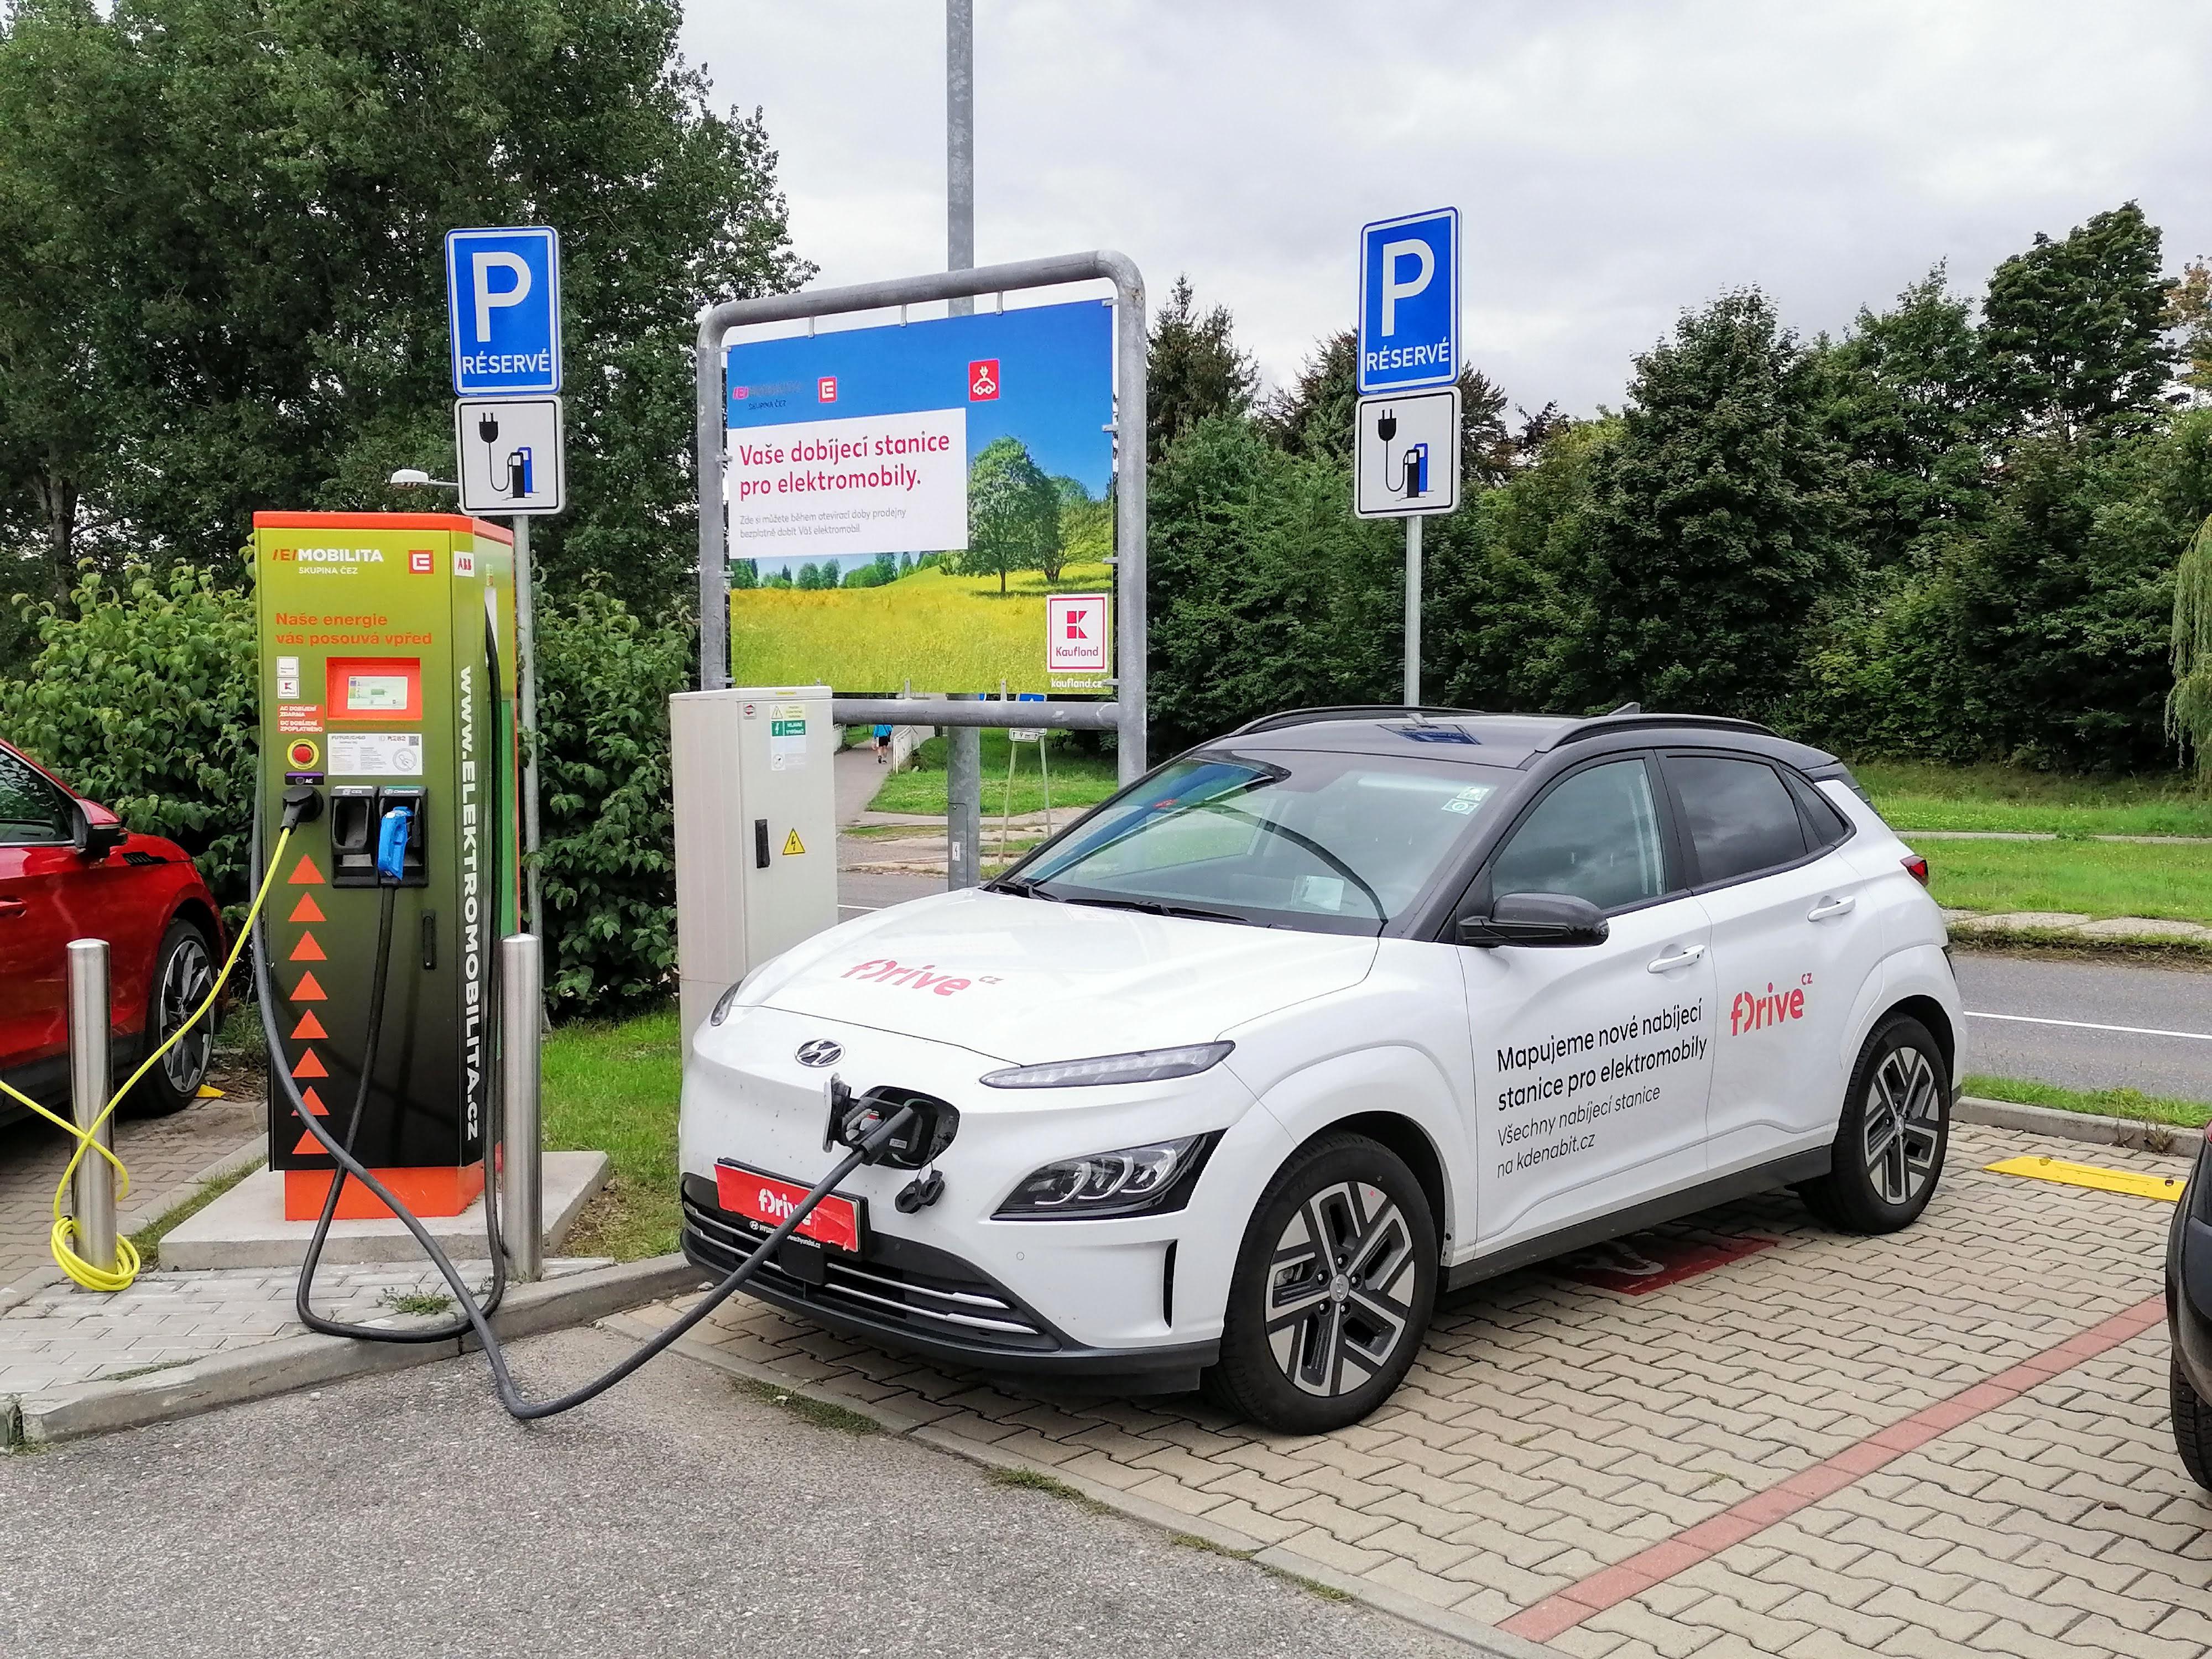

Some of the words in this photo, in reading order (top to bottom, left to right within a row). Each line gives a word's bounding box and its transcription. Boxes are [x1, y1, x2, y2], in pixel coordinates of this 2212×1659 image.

[472, 251, 531, 342] P
[1381, 238, 1435, 336] P
[462, 348, 550, 374] RÉSERVÉ
[1366, 336, 1449, 372] RÉSERVÉ
[739, 444, 784, 466] Vaše
[791, 436, 868, 465] dobíjecí
[875, 431, 950, 456] stanice
[740, 479, 771, 502] pro
[778, 463, 921, 493] elektromobily.
[740, 515, 754, 525] Zde
[852, 509, 871, 520] doby
[873, 508, 906, 519] prodejny
[340, 566, 358, 575] ČEZ
[457, 557, 472, 570] ABB
[276, 612, 318, 625] Naše
[323, 613, 388, 629] energie
[276, 632, 304, 644] vás
[309, 632, 379, 647] posouvá
[385, 632, 432, 647] vpřed
[1056, 646, 1099, 657] Kaufland
[1051, 678, 1103, 688] kaufland.cz
[1496, 1033, 1594, 1072] Mapujeme
[1599, 1015, 1639, 1047] nové
[1642, 998, 1702, 1035] nabíjecí
[1498, 1077, 1563, 1112] stanice
[1568, 1070, 1596, 1097] pro
[1600, 1035, 1708, 1082] elektromobily
[1497, 1116, 1556, 1146] Všechny
[1558, 1094, 1613, 1128] nabíjecí
[1614, 1086, 1660, 1112] stanice
[1496, 1160, 1513, 1178] na
[1516, 1134, 1595, 1171] kdenabit.cz
